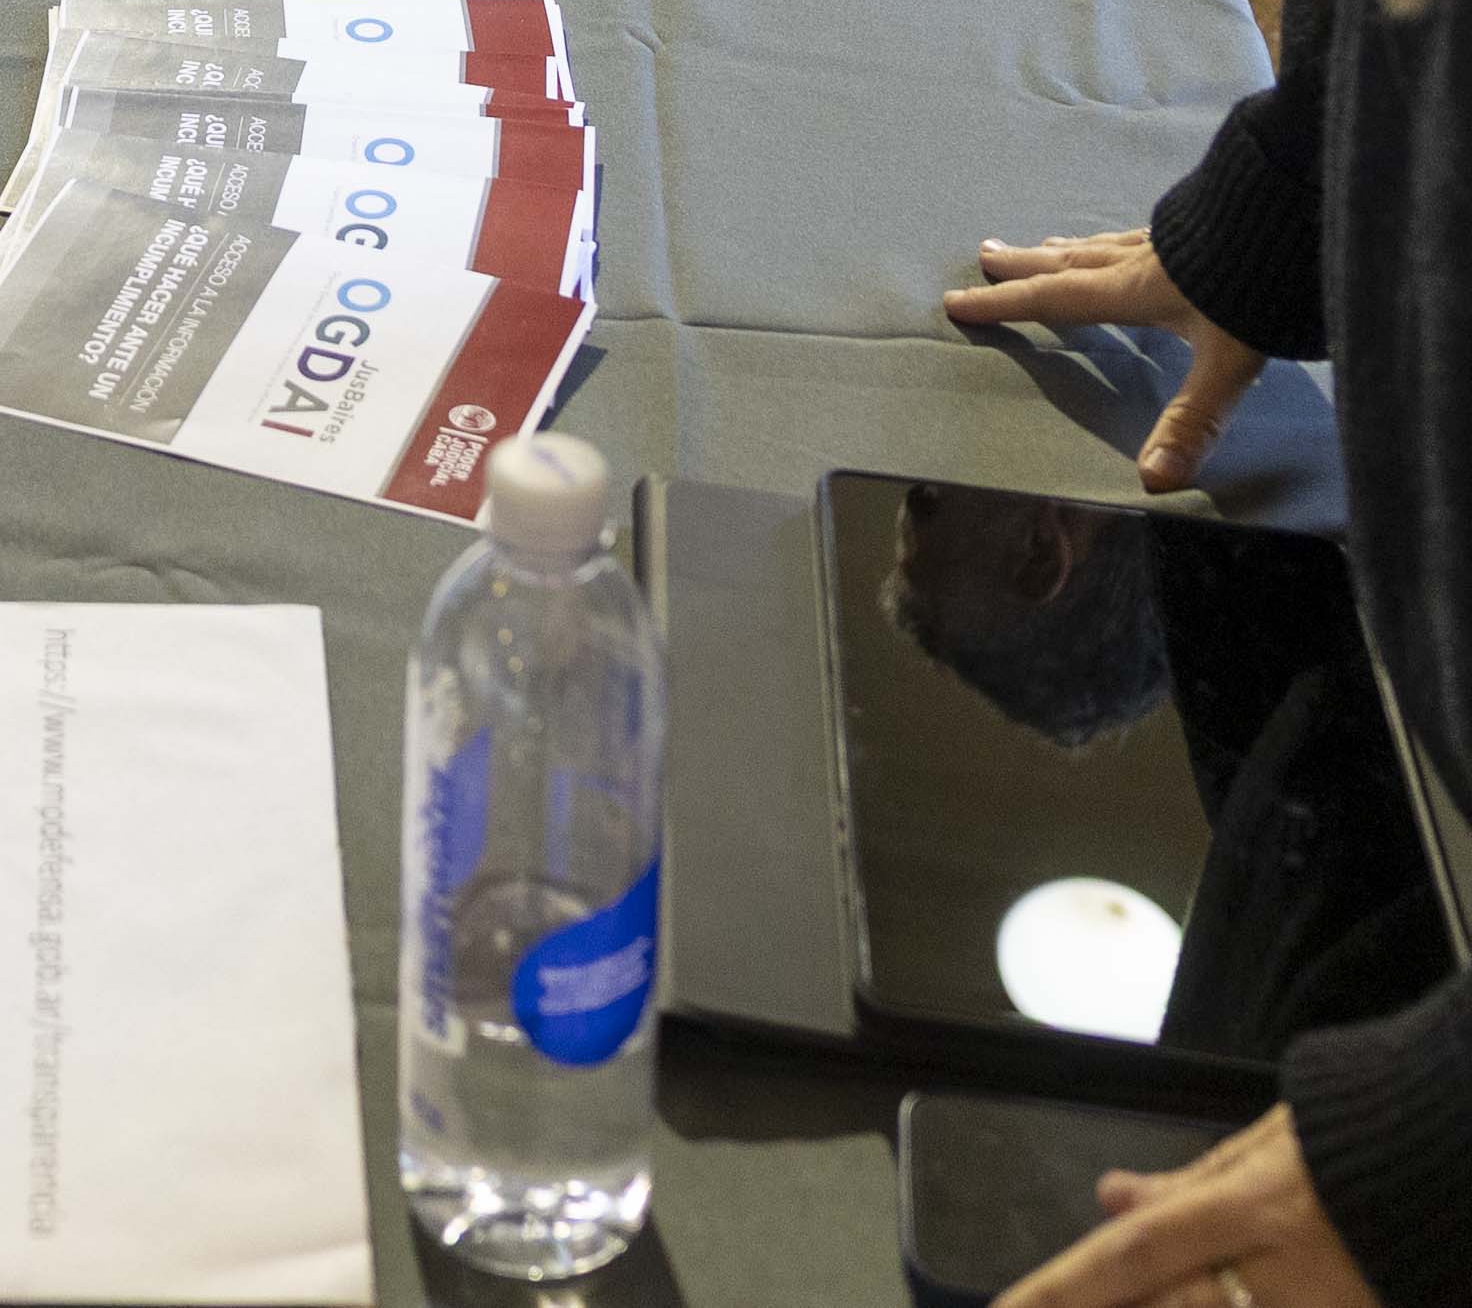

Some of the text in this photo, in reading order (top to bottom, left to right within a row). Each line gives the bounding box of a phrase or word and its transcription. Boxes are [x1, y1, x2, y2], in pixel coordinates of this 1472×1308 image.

[180, 158, 207, 196] ¿QUÉ
[220, 164, 249, 210] ACCESO
[78, 219, 186, 364] INCUMPLIMIENTO?
[88, 225, 209, 400] ¿QUÉ HACER ANTE UN
[129, 234, 252, 414] ACCESO A LA INFORMACIÓN
[261, 278, 391, 438] OGDAI
[319, 360, 380, 444] JusBaires
[424, 434, 452, 466] CABA
[430, 437, 467, 487] JUDICIAL
[449, 441, 484, 481] PODER
